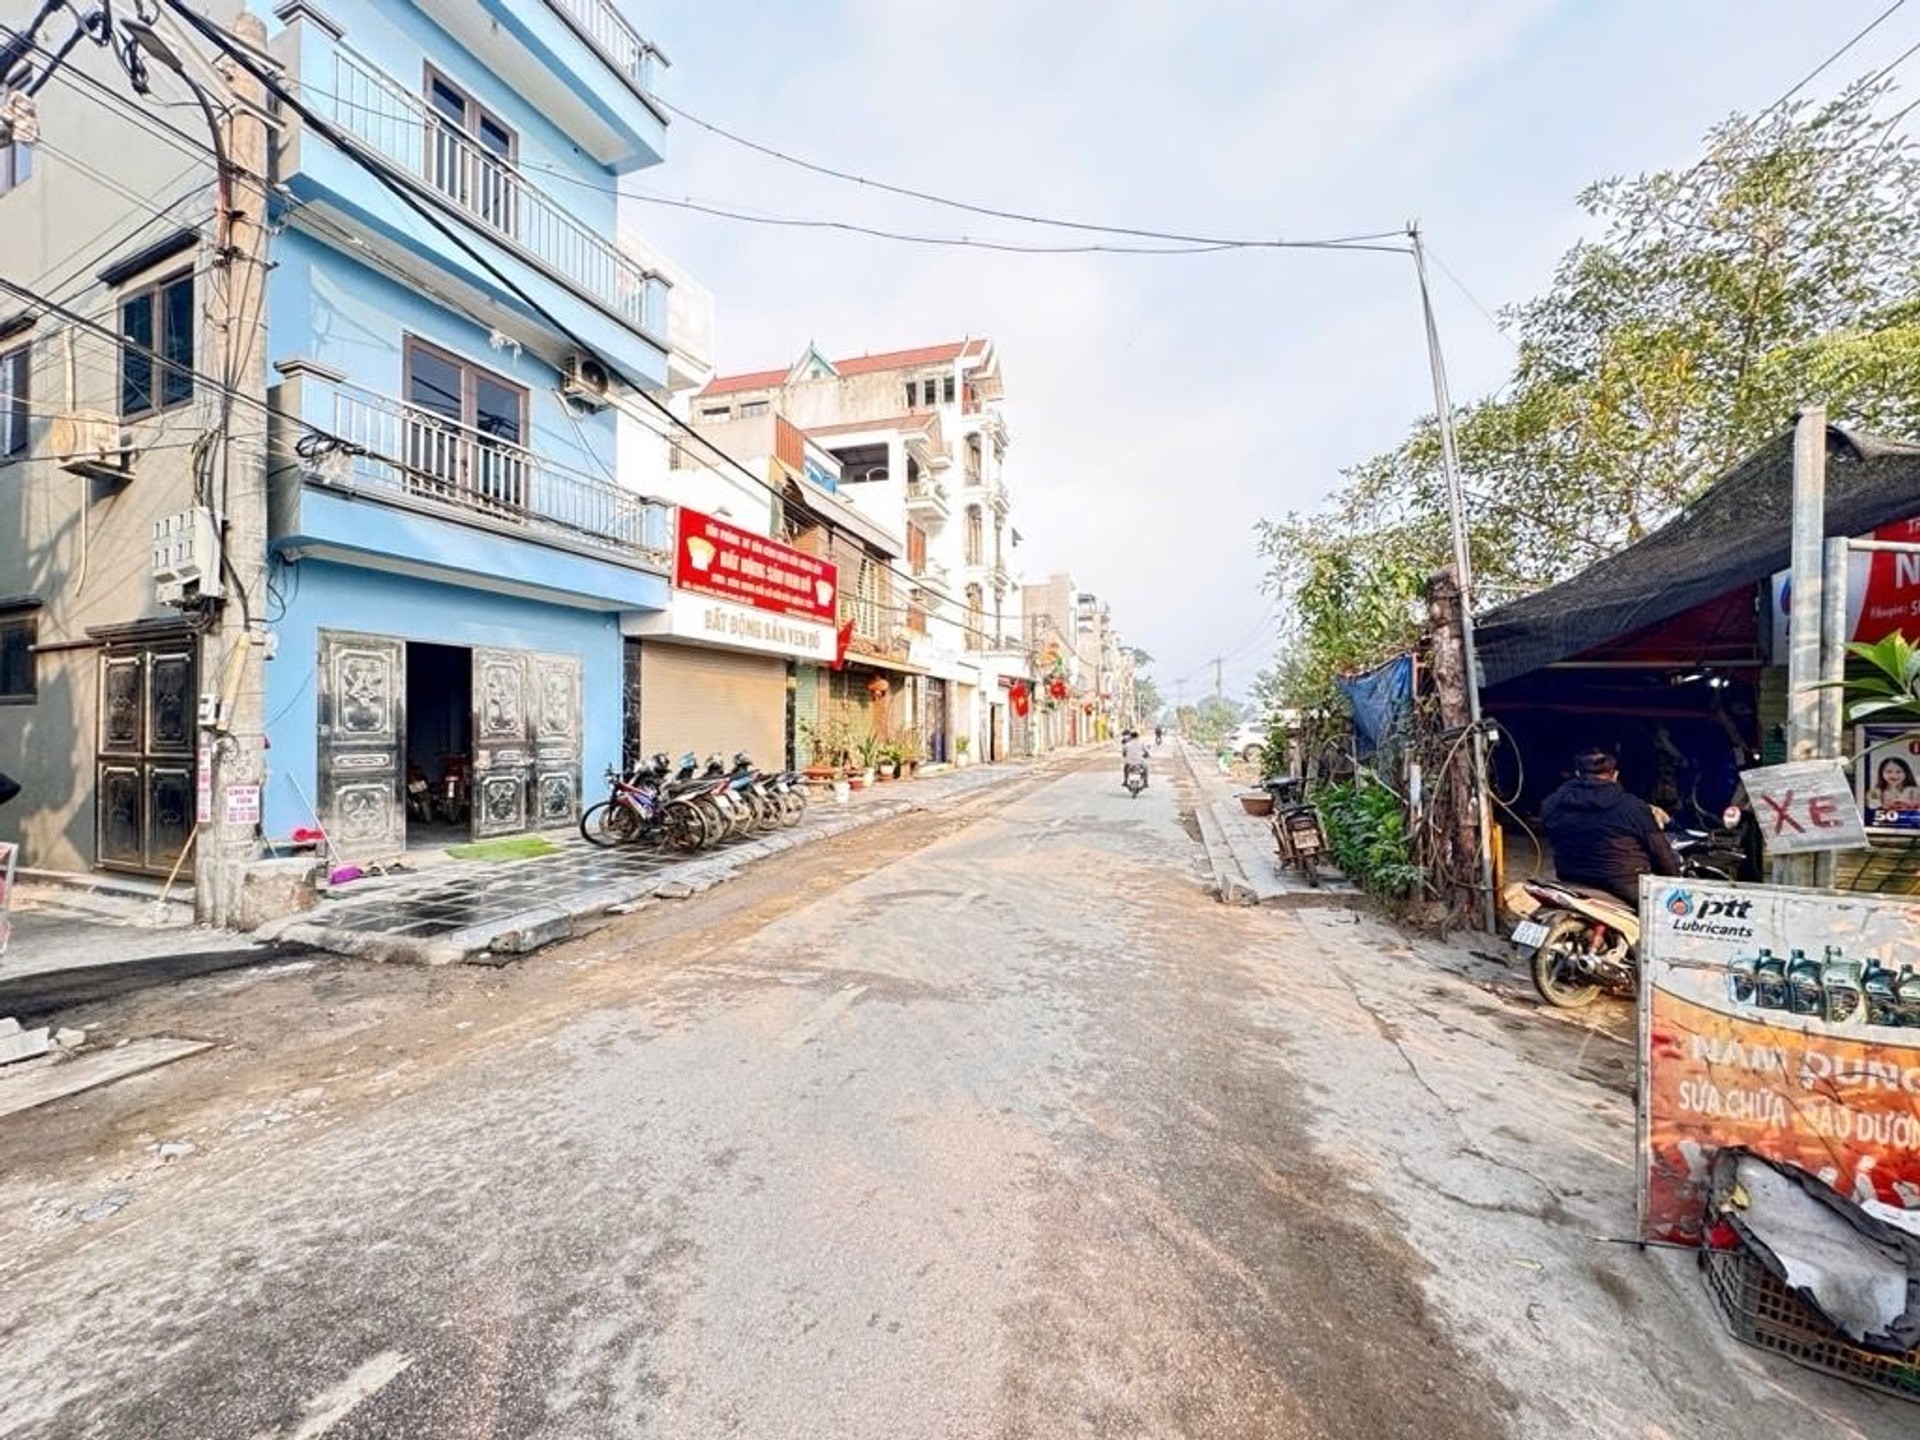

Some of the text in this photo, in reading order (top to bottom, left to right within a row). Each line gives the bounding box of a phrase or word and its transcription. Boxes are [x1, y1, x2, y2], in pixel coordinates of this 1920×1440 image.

[704, 607, 730, 632] BẤT
[730, 611, 762, 640] ĐỘNG
[764, 618, 787, 644] SẢN
[1760, 789, 1844, 836] XE
[1696, 899, 1754, 919] ptt
[1673, 918, 1753, 938] Lubricants
[1724, 1086, 1787, 1128] CHỮA
